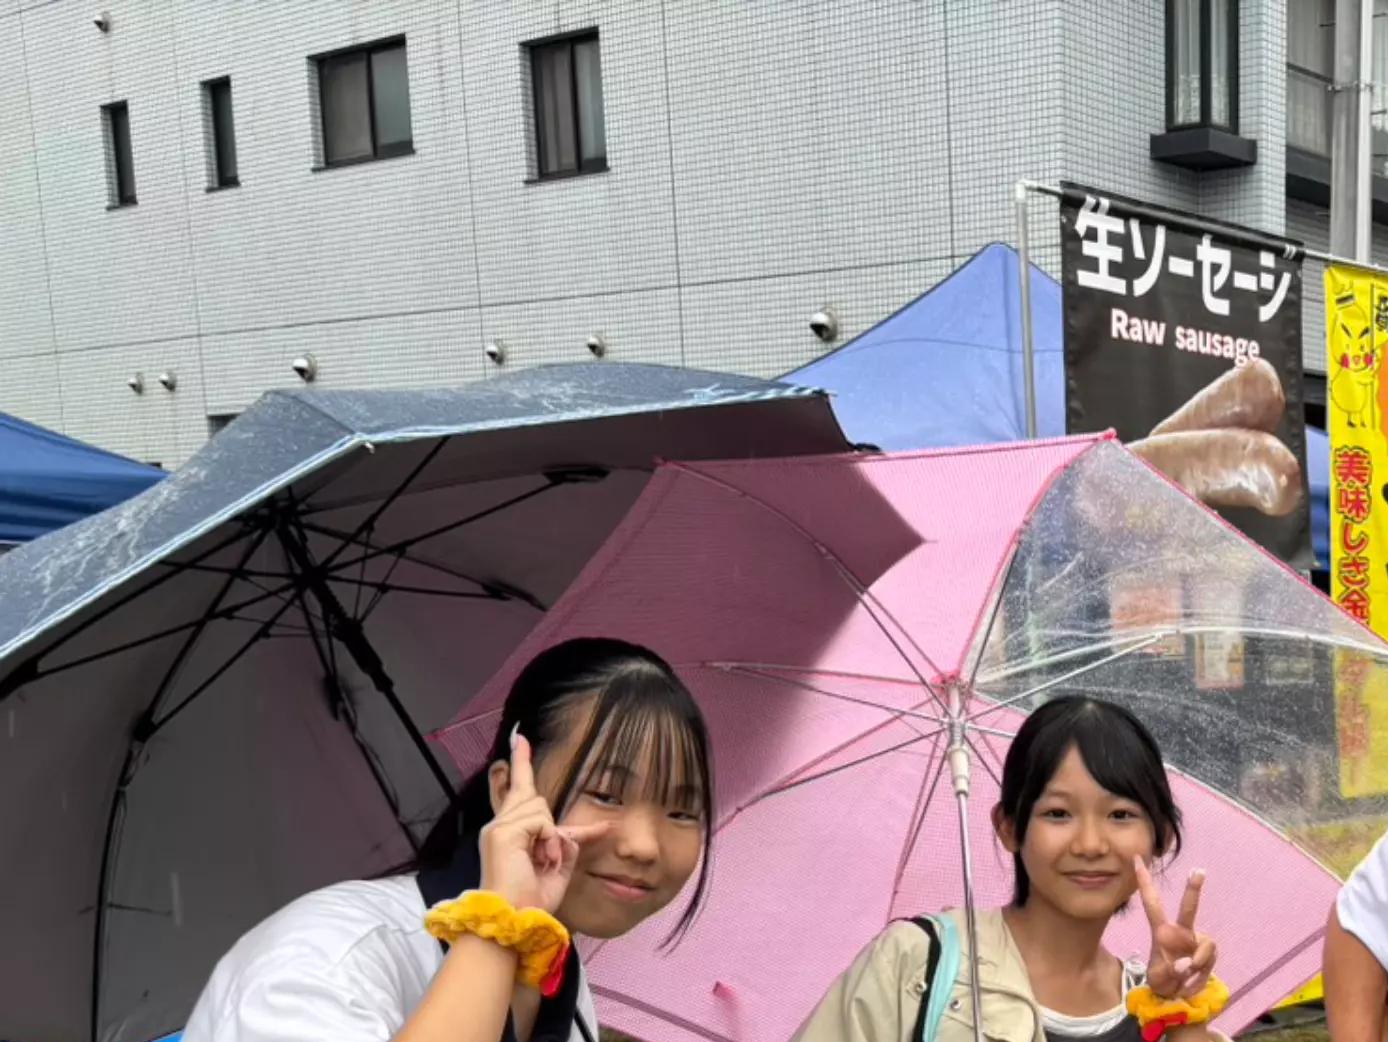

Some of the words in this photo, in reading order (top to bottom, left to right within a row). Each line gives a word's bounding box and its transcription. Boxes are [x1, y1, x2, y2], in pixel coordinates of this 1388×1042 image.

[1075, 194, 1296, 322] 生ソーセージ
[1111, 308, 1166, 346] Raw
[1175, 325, 1260, 367] sausage
